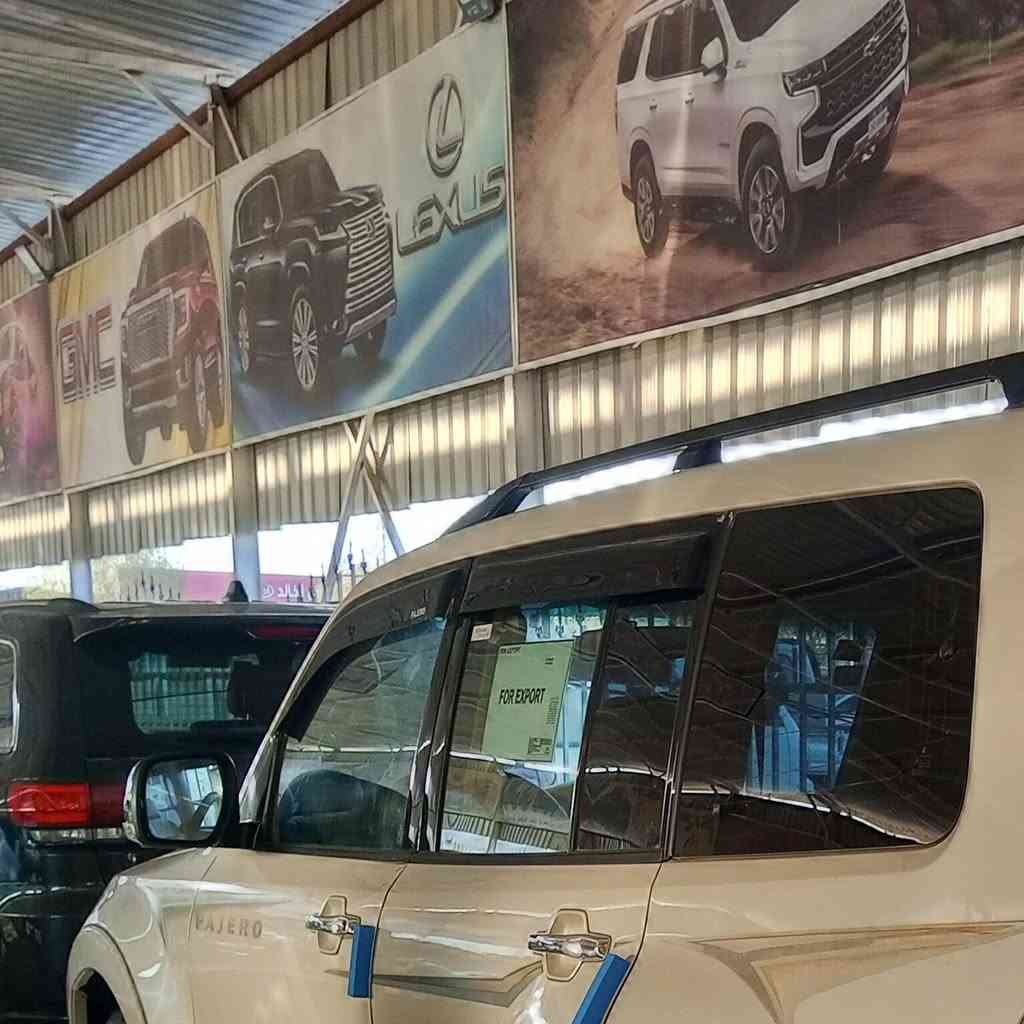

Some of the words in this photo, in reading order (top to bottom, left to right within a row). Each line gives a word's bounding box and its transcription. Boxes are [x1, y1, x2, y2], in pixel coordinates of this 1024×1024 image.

[394, 165, 507, 256] LEXUS
[60, 304, 117, 404] GMC
[499, 690, 513, 704] FOR
[515, 688, 546, 704] EXPORT
[195, 912, 263, 938] PAJERO
